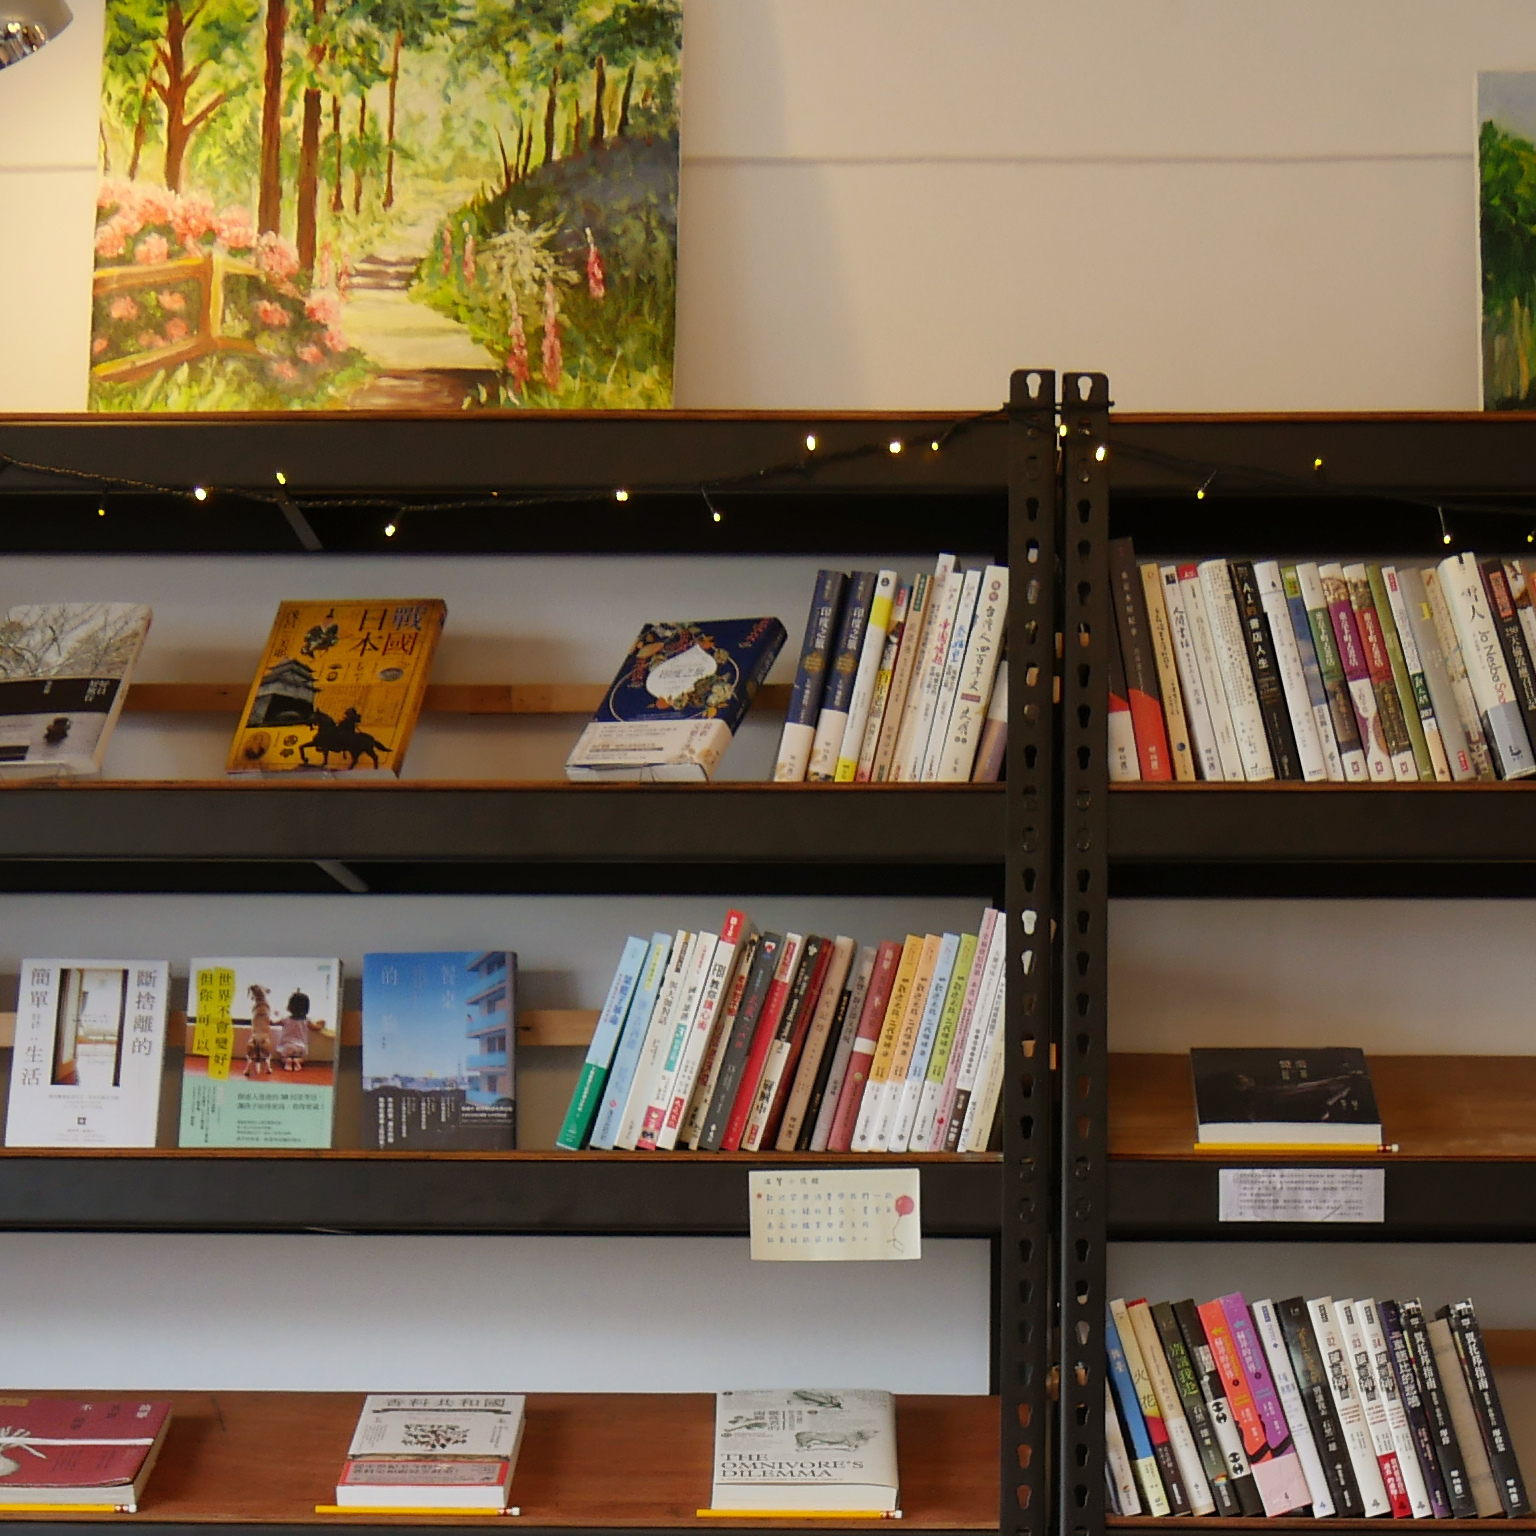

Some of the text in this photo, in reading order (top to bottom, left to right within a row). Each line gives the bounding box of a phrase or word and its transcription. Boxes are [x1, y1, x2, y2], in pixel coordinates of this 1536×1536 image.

[347, 606, 427, 656] 戰國 日本
[22, 967, 52, 1086] 簡單 生活
[132, 969, 157, 1056] 斷捨離的
[1134, 1369, 1157, 1409] 火花
[721, 1461, 864, 1469] OMNIVORE'S
